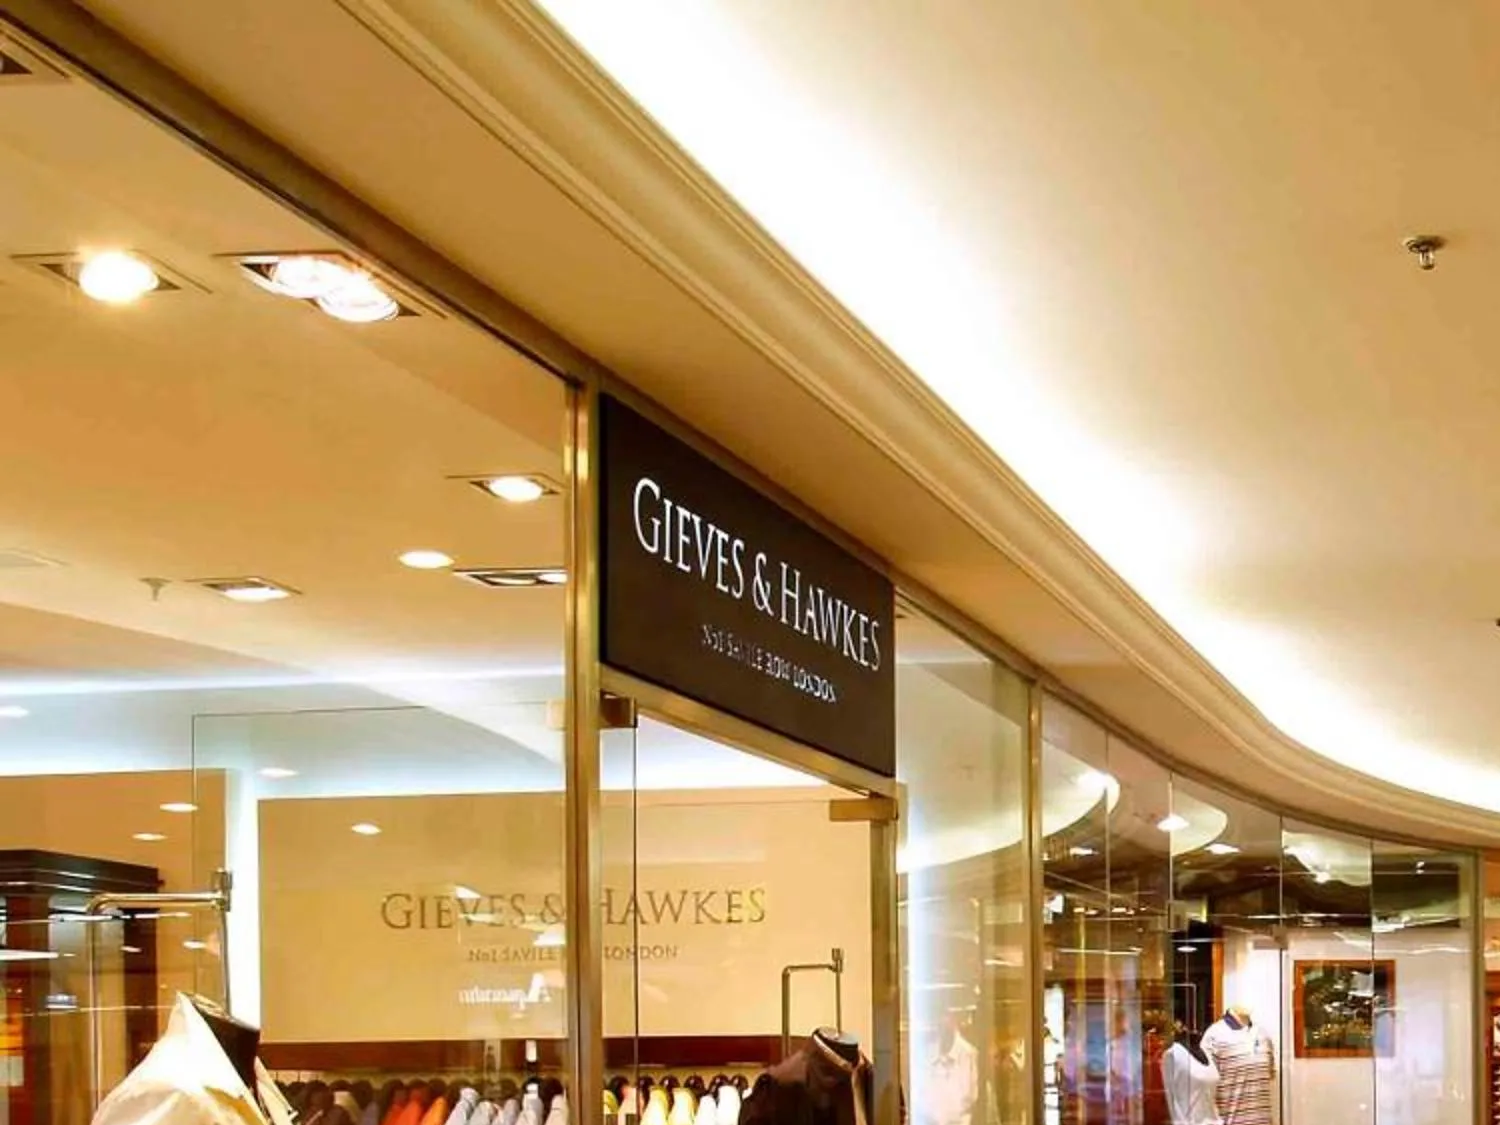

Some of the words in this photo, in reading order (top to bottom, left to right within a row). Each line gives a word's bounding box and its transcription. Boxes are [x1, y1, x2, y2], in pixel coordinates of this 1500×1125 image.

[633, 477, 744, 600] GIEVES
[752, 552, 774, 615] &
[780, 561, 882, 672] HAWKES
[381, 893, 527, 930] GIEVES
[540, 893, 566, 926] &
